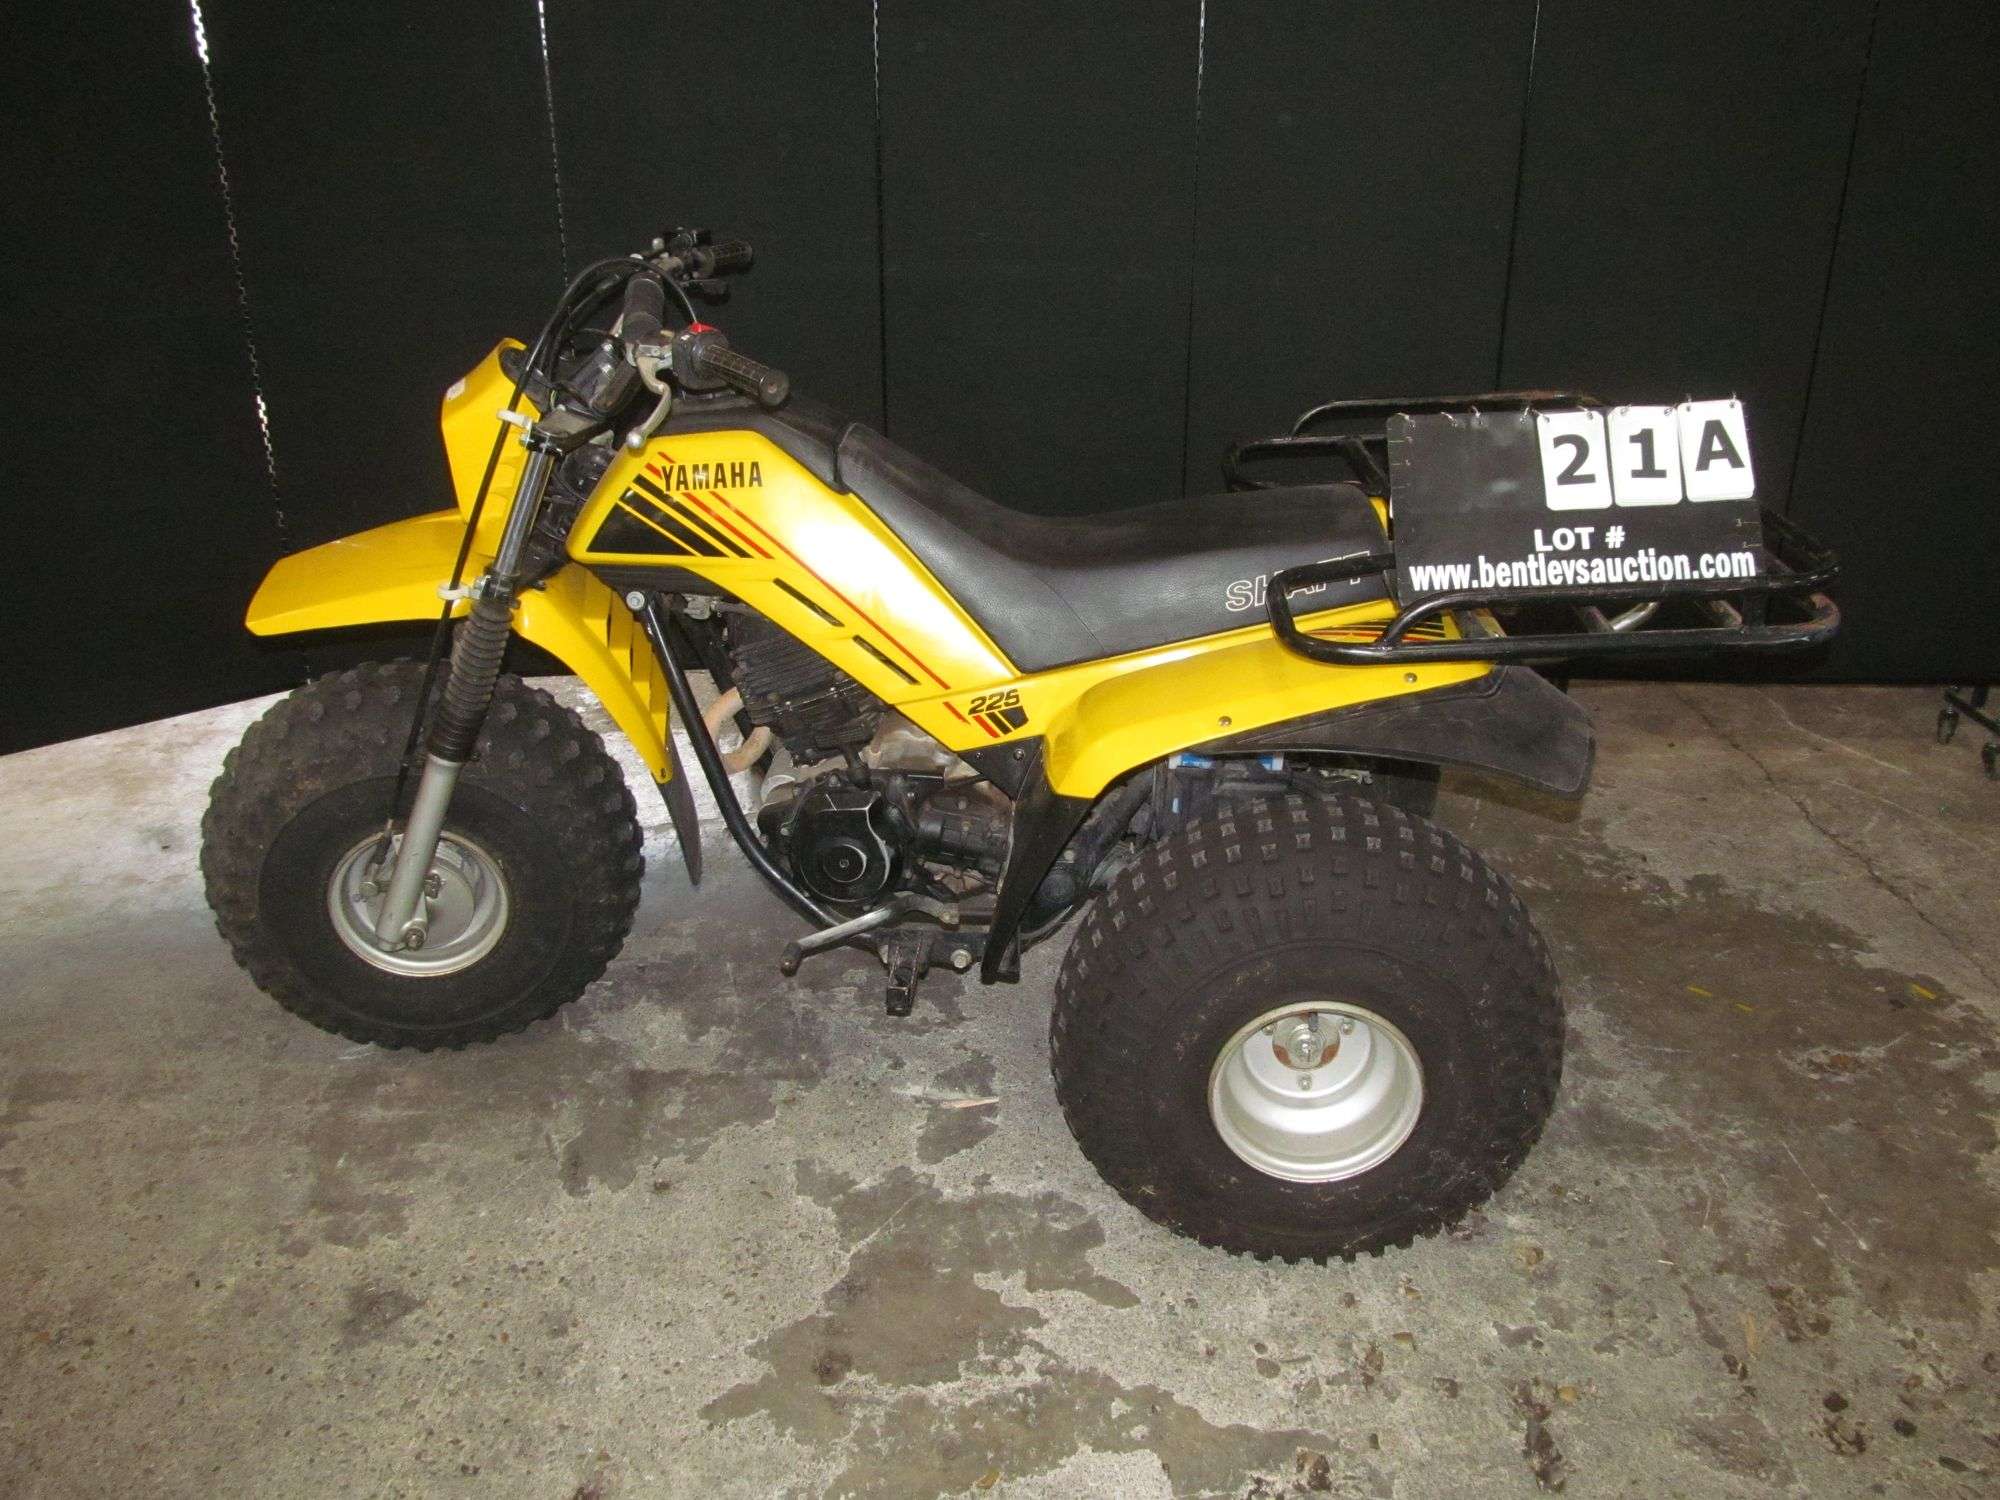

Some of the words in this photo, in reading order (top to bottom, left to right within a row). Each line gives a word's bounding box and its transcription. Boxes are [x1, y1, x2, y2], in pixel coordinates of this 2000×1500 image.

[661, 461, 763, 492] YAMAHA
[1533, 526, 1595, 553] LOT
[1604, 525, 1627, 550] #
[968, 689, 1021, 715] 225
